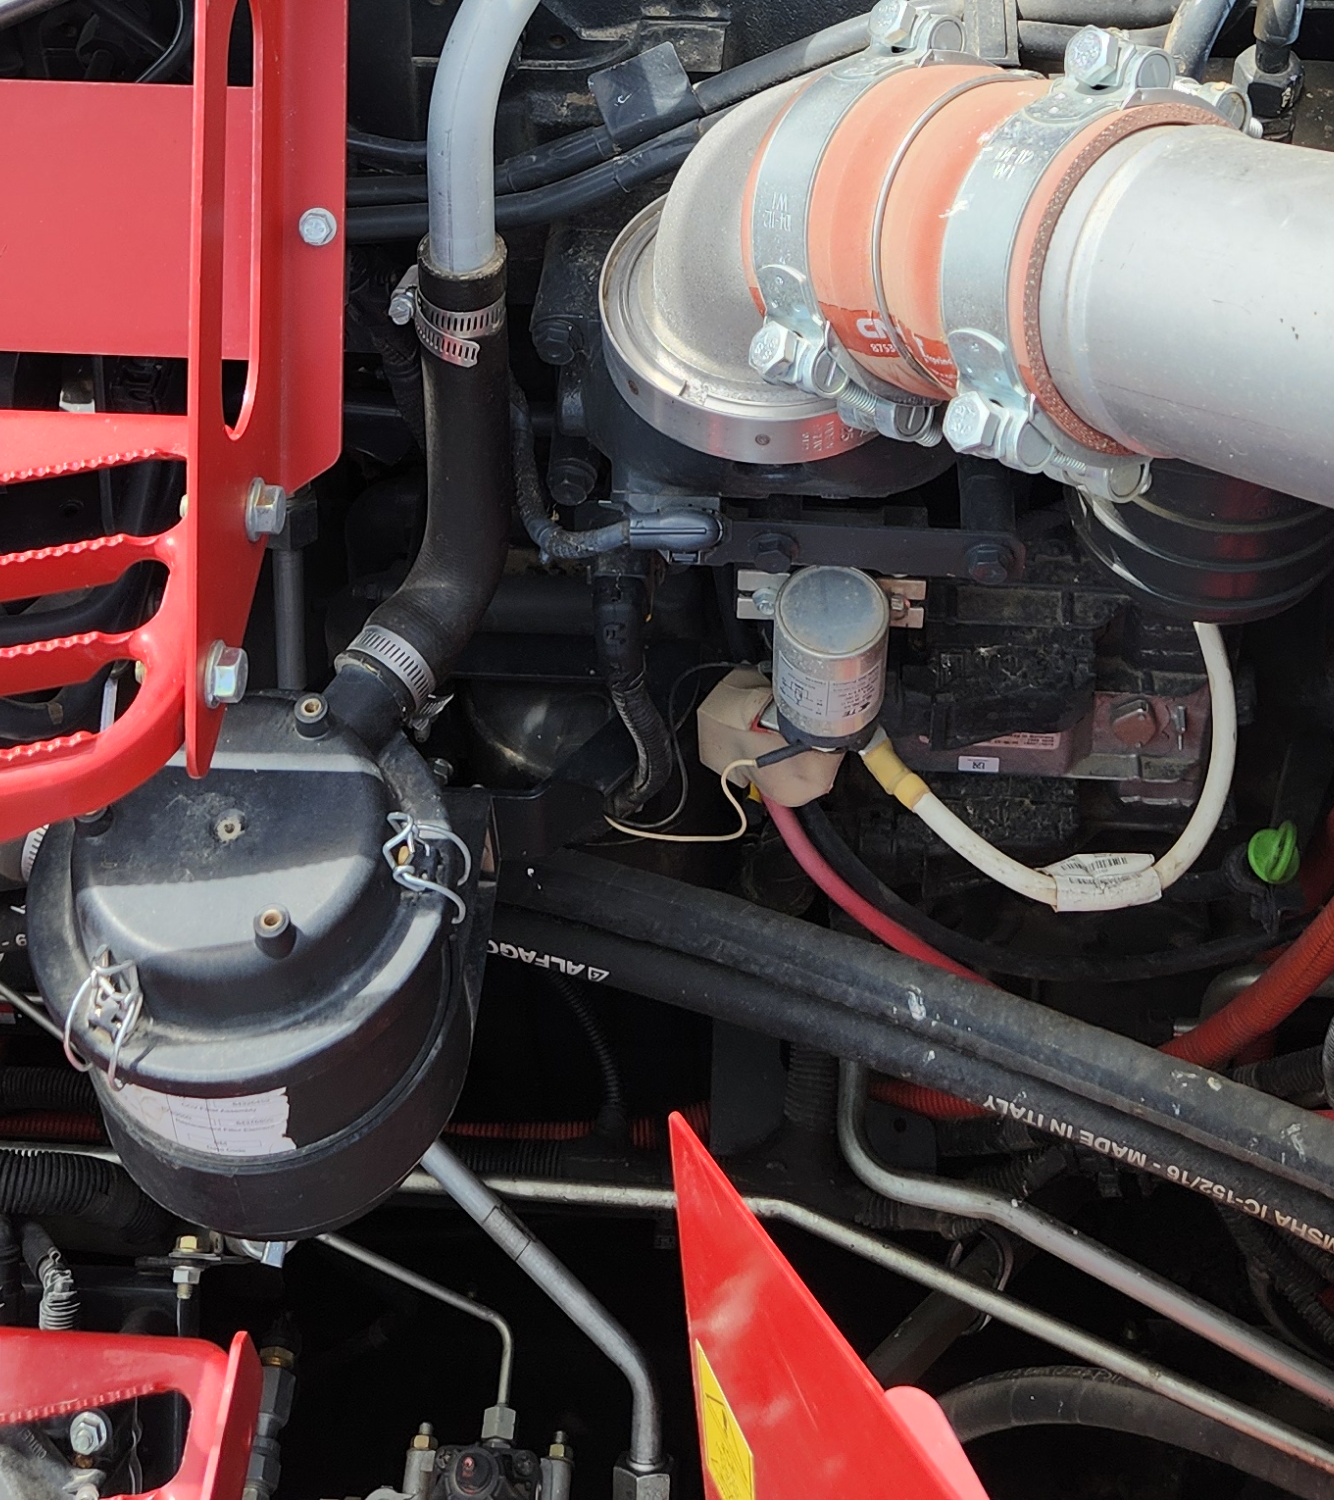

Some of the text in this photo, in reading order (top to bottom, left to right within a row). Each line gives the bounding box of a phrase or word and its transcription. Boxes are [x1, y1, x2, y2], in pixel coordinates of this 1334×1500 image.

[487, 939, 586, 976] ALFAGO
[982, 1093, 1045, 1130] ITALY
[1050, 1117, 1074, 1141] IN
[1079, 1129, 1148, 1167] MADE
[1167, 1163, 1267, 1220] IC-152/16
